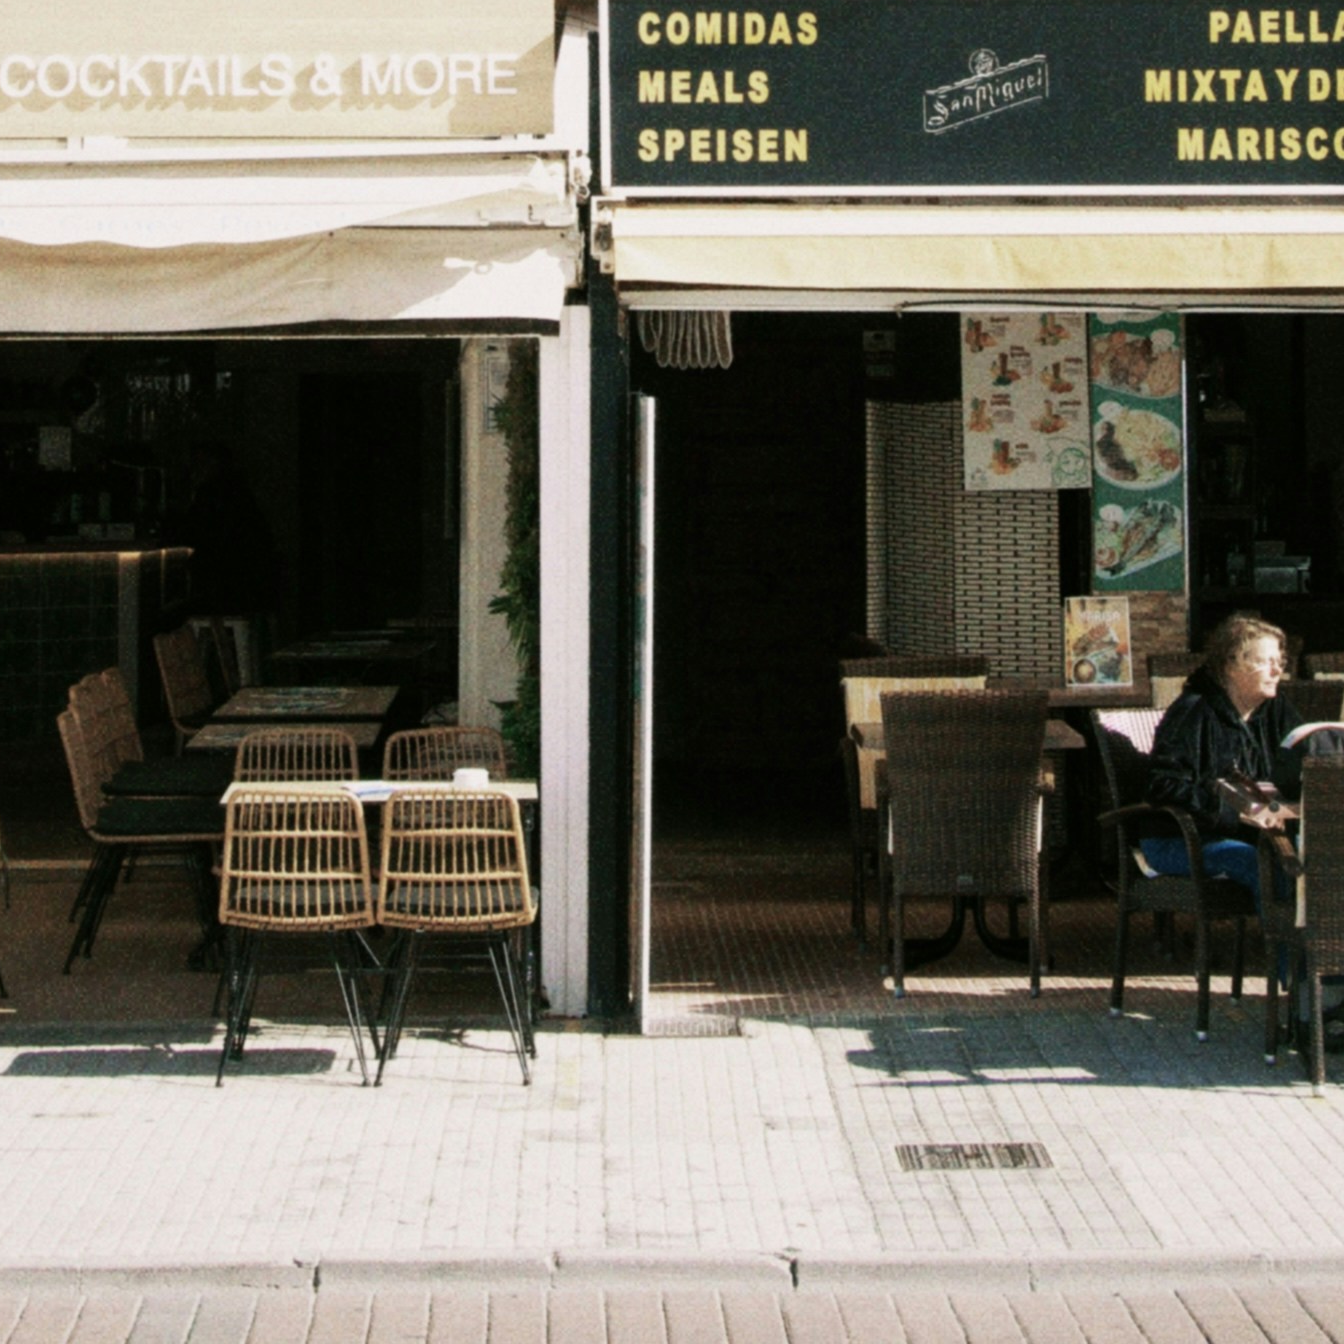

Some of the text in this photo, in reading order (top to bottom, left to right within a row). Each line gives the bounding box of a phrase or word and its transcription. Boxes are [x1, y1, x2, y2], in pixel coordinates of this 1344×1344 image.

[637, 11, 820, 47] COMIDAS
[309, 55, 342, 97] &
[359, 55, 519, 96] MORE
[637, 70, 772, 105] MEALS
[1144, 69, 1268, 105] MIXTA
[1275, 69, 1299, 104] Y
[637, 128, 809, 164] SPEISEN
